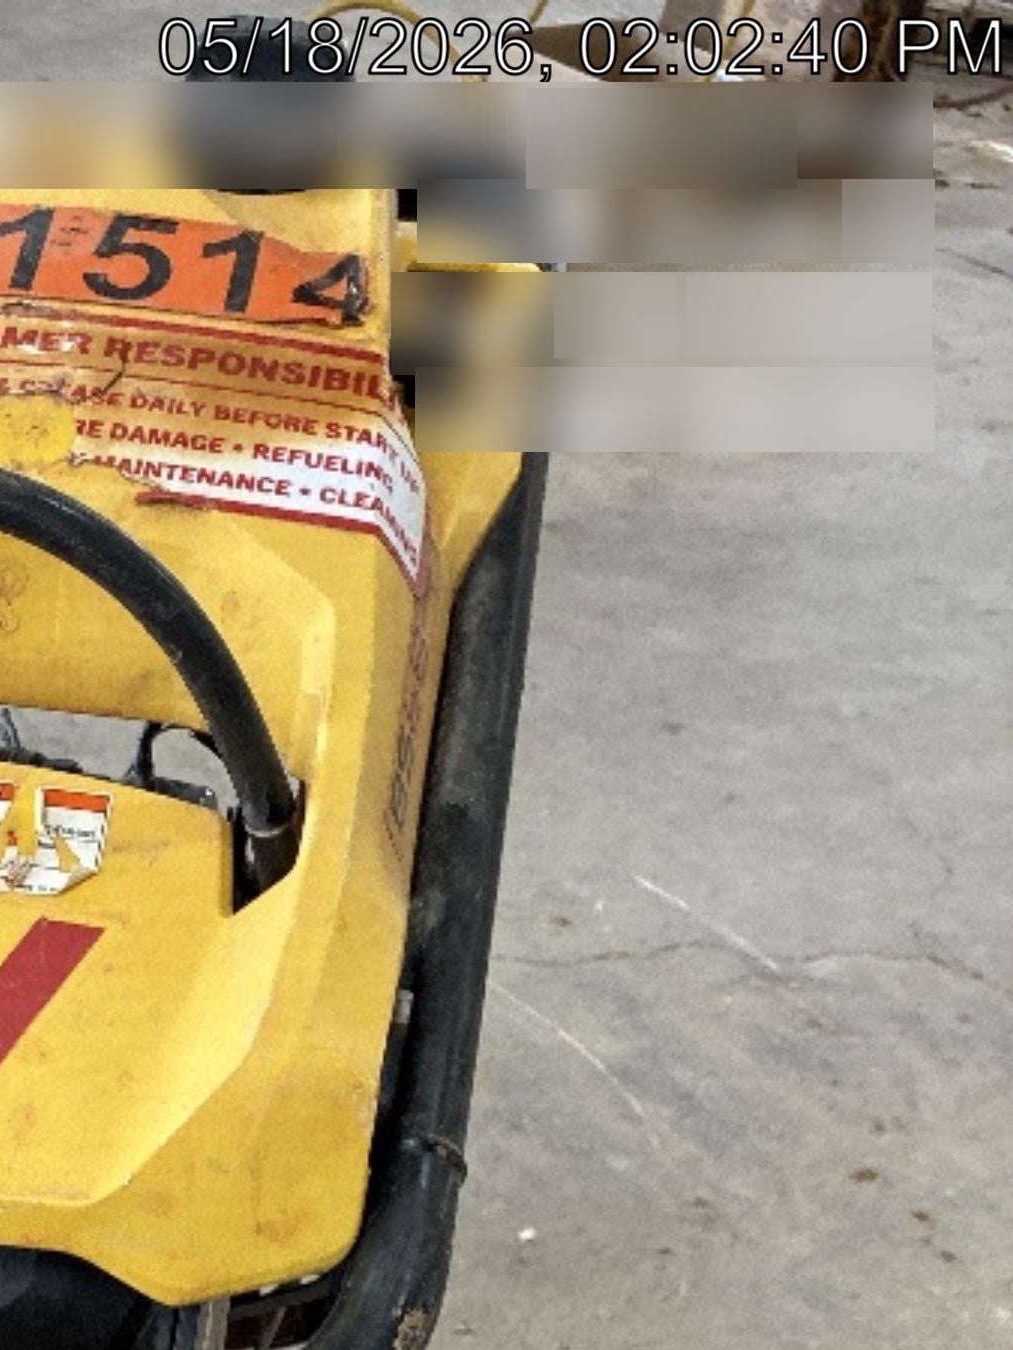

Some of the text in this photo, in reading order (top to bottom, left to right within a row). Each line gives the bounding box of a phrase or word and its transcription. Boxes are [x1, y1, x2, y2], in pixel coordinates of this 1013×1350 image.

[130, 392, 207, 419] DAILY
[214, 404, 319, 436] BEFORE
[110, 422, 225, 454] DAMAGE
[252, 442, 394, 496] REFUELING
